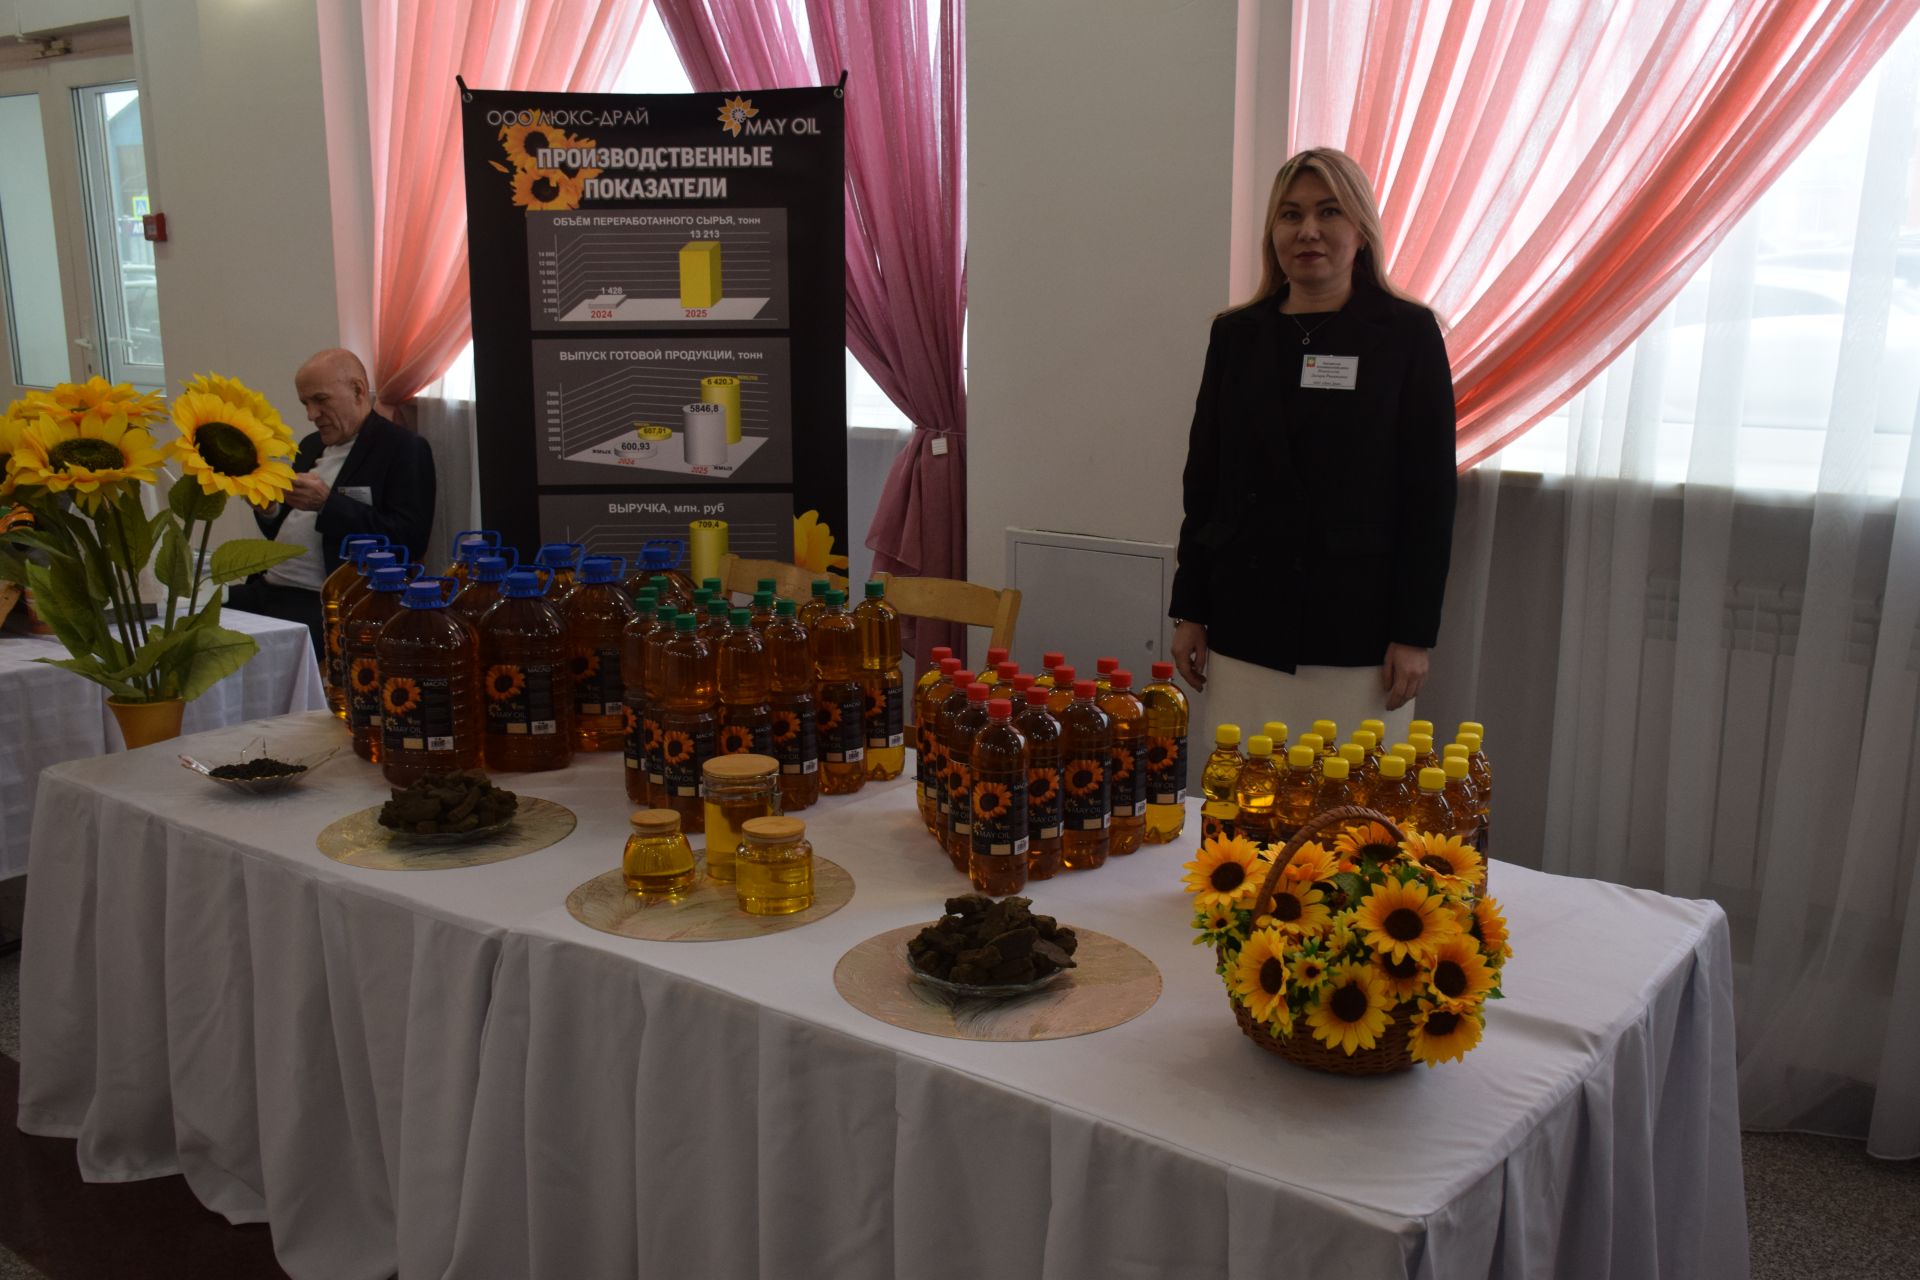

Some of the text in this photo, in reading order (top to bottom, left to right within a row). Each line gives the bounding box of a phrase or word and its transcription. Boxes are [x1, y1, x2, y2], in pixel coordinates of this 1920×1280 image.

[486, 107, 649, 127] ООО ЛЮКС-ДРАЙ
[745, 118, 821, 136] MAY OIL
[537, 146, 773, 171] ПРОИЗВОДСТВЕННЫЕ
[584, 177, 727, 200] ПОКАЗАТЕЛИ
[553, 215, 591, 227] ОБЪЁМ
[593, 216, 695, 226] ПЕРЕРАБОТАННОГО
[696, 216, 736, 227] СЫРЬЯ,
[690, 230, 721, 239] 13 213
[590, 310, 613, 319] 2024
[685, 309, 708, 318] 2025
[559, 349, 763, 362] ВЫПУСК ГОТОВОЙ ПРОДУКЦИИ, тонн
[621, 442, 650, 451] 600,93
[608, 503, 725, 515] ВЫРУЧКА, млн. руб
